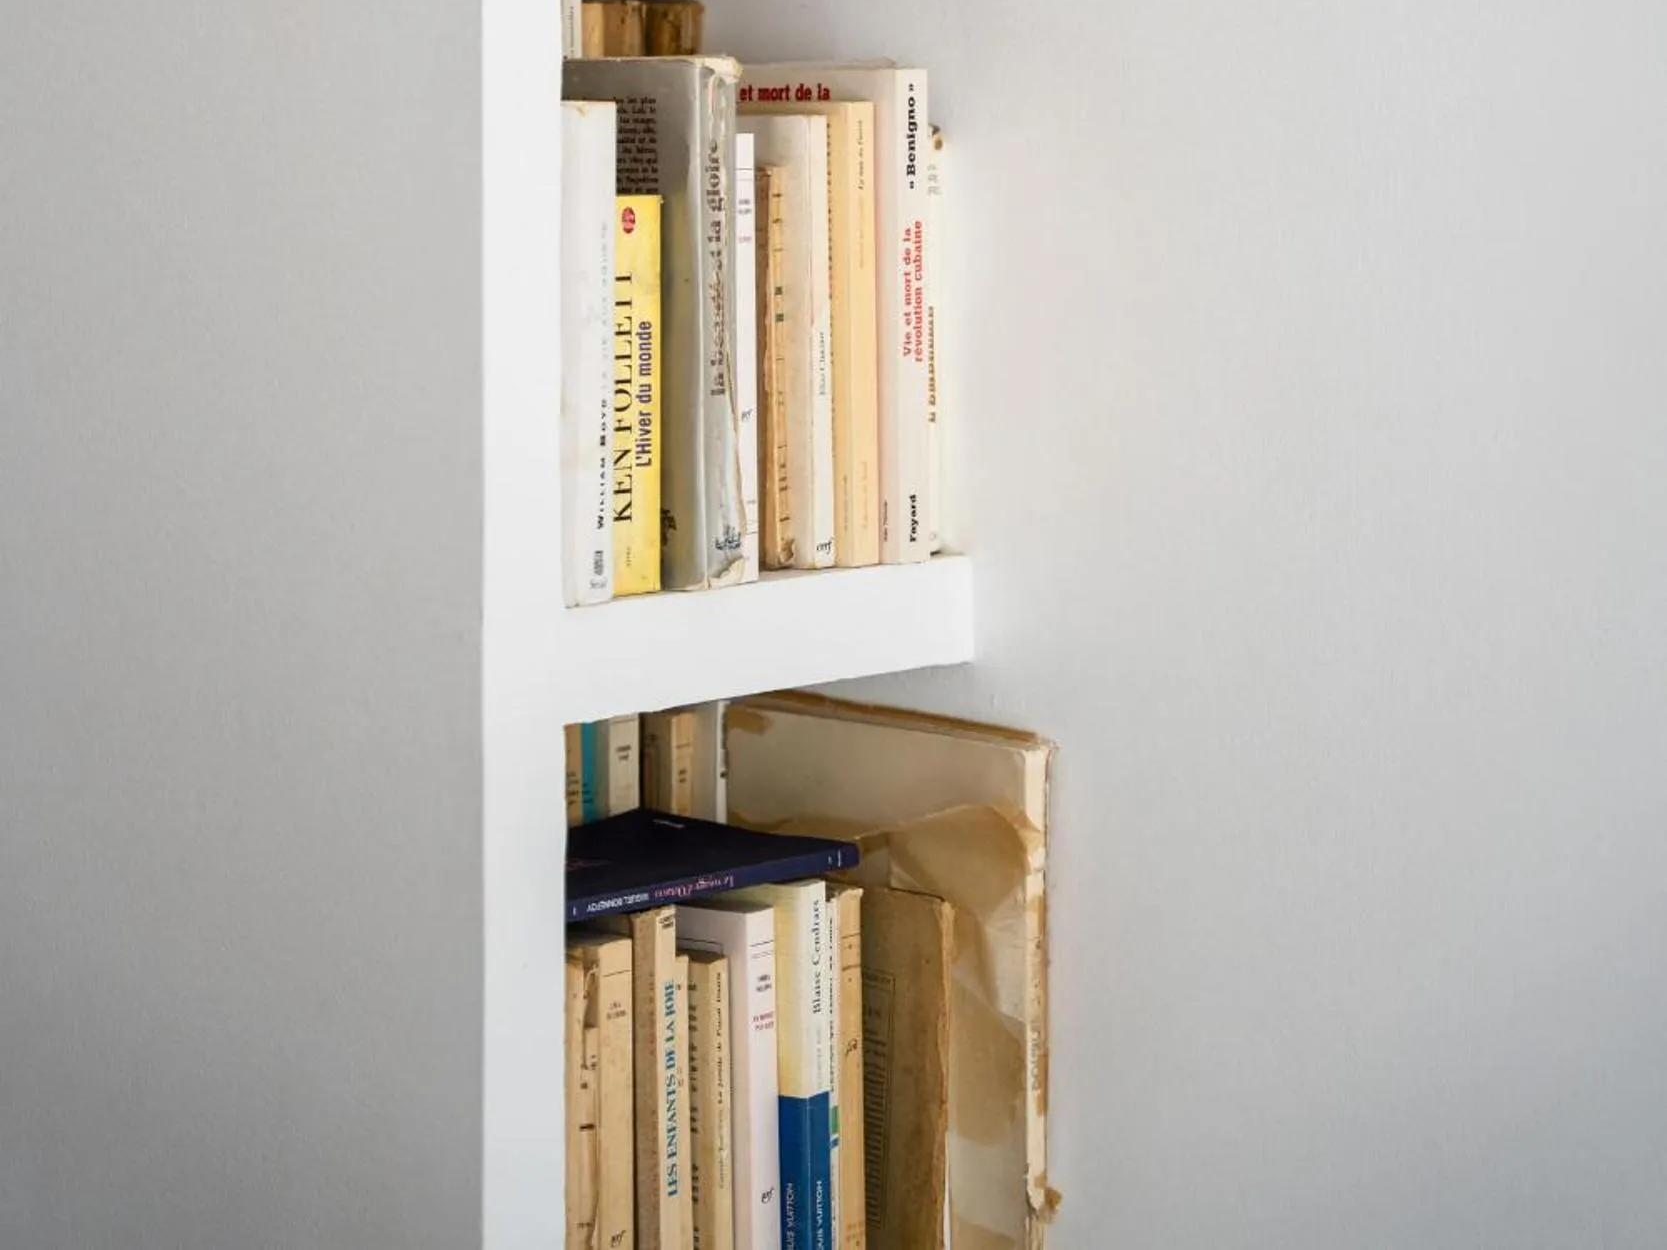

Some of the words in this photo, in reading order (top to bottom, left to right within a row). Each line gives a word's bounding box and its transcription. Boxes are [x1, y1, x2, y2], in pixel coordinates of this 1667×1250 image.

[740, 84, 753, 101] et
[758, 84, 791, 102] mort
[795, 83, 812, 102] de
[818, 83, 831, 102] la
[906, 96, 918, 176] Benigno
[703, 139, 723, 213] gloire
[706, 219, 721, 243] la
[902, 227, 911, 242] la
[912, 220, 923, 281] cubaine
[902, 247, 911, 266] de
[903, 271, 912, 306] mort
[904, 311, 912, 326] et
[912, 286, 923, 363] révolution
[634, 320, 653, 377] monde
[903, 332, 912, 357] Vie
[635, 383, 653, 405] du
[634, 409, 653, 467] L'Hiver
[613, 448, 633, 523] KEN
[909, 494, 919, 543] Fayard
[811, 898, 820, 966] Cendrars
[663, 980, 676, 1016] JOIE
[812, 971, 822, 1014] Blaise
[664, 1020, 675, 1044] LA
[664, 1048, 676, 1071] DE
[665, 1073, 678, 1158] ENFANTS
[666, 1163, 678, 1197] LES
[815, 1179, 824, 1227] VUITTON
